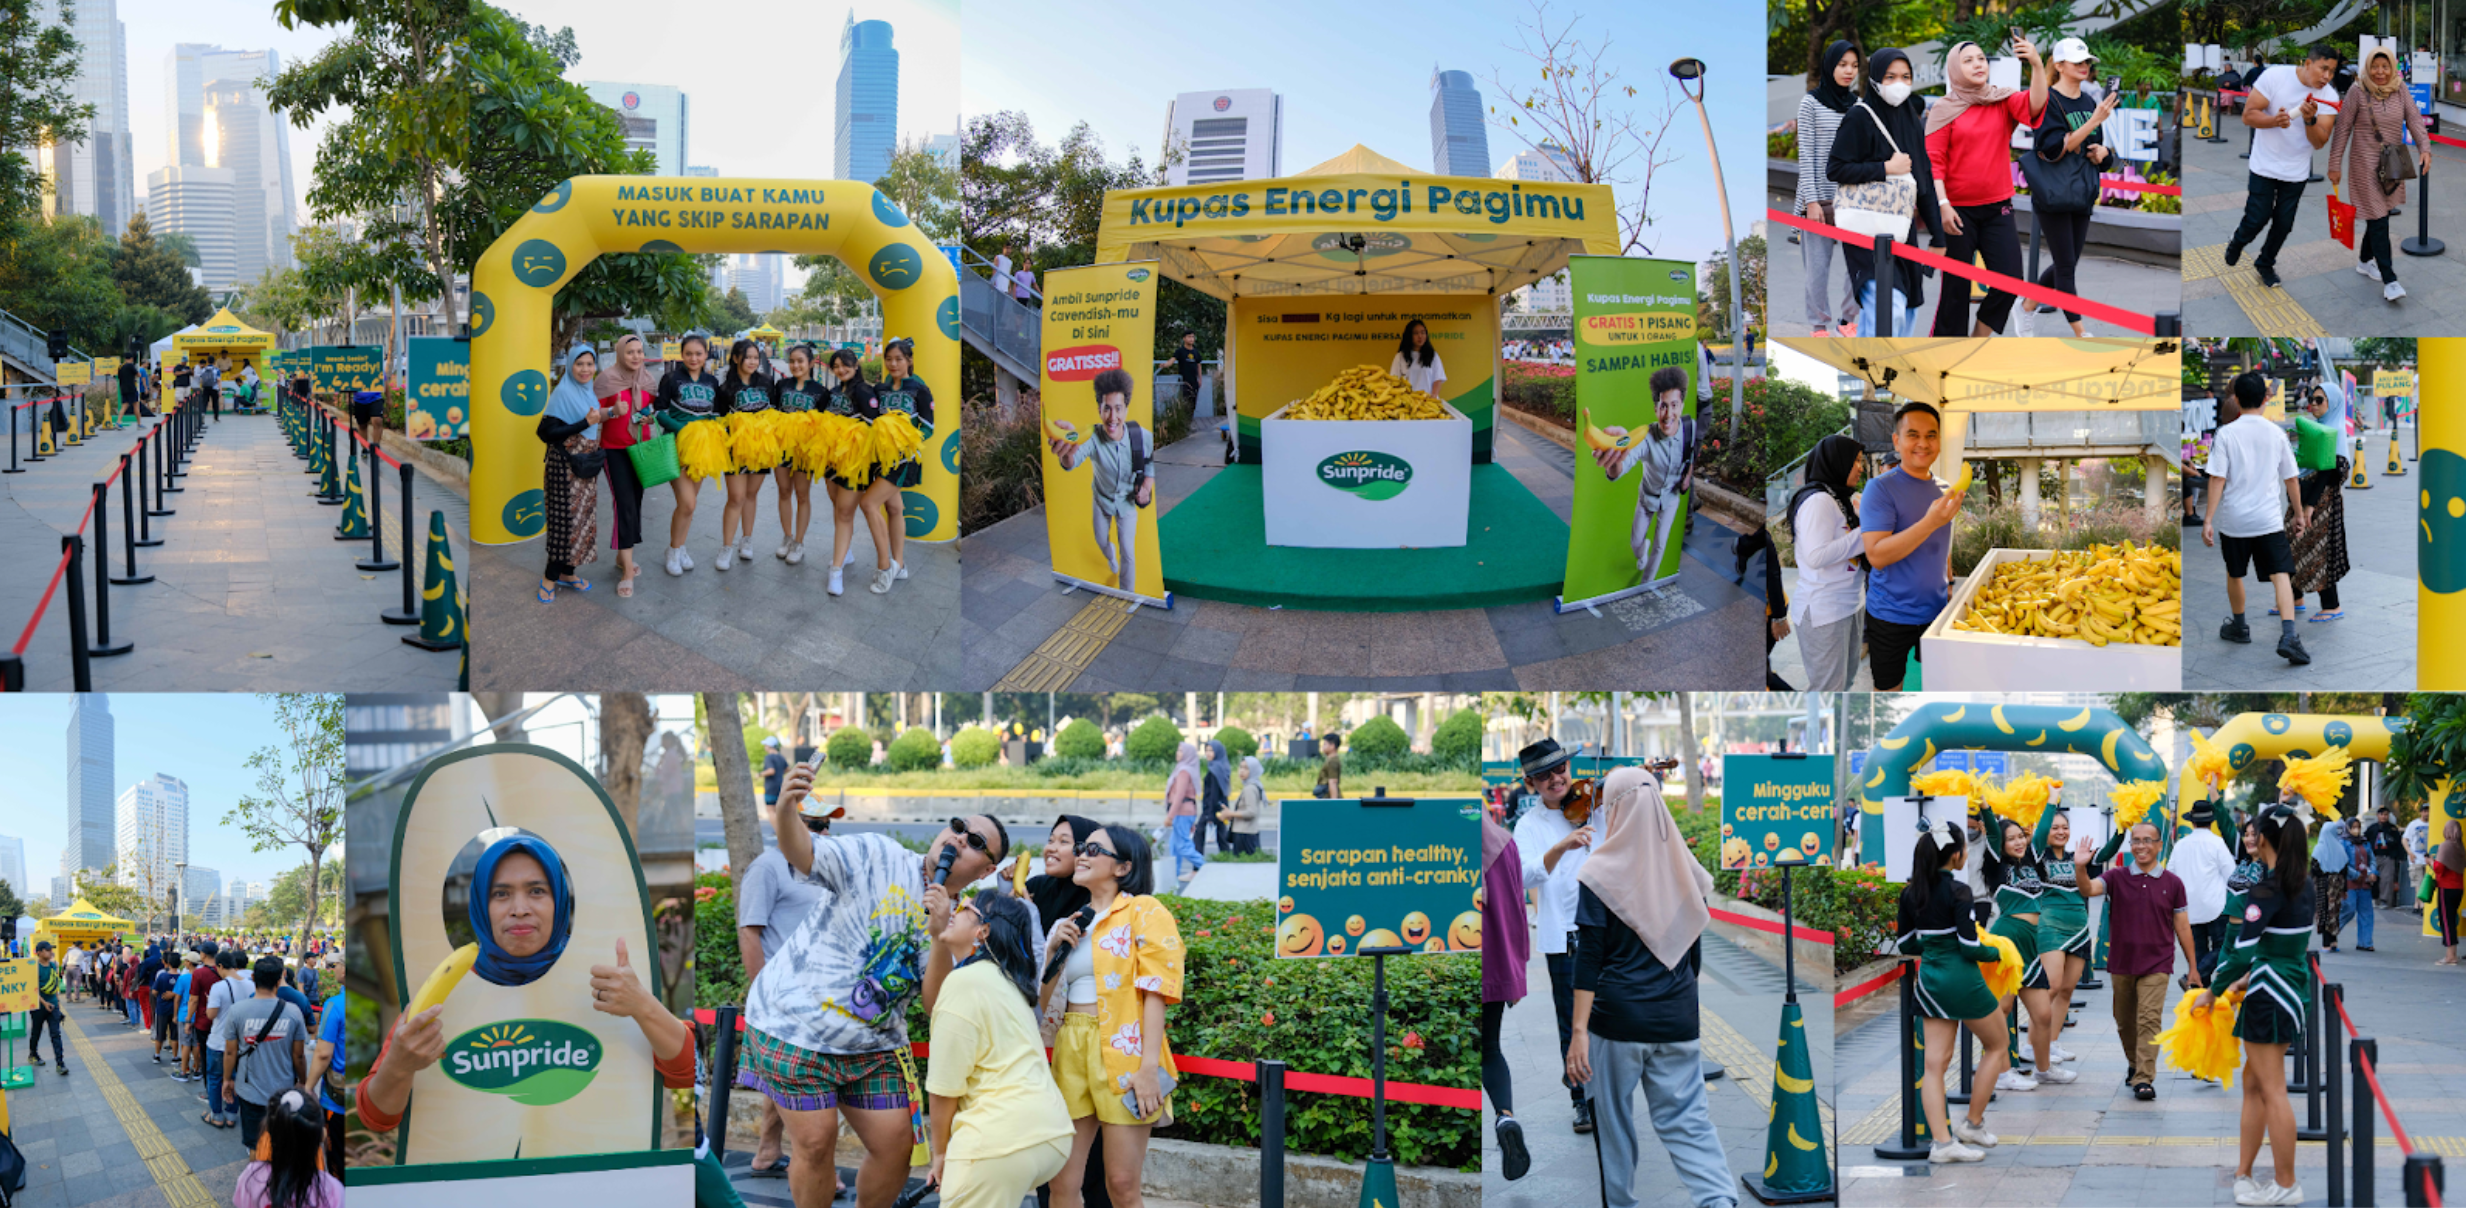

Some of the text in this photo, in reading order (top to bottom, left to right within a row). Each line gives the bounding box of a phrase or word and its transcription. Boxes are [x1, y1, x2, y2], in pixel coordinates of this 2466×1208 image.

[617, 185, 825, 205] MASUK BUAT KAMU
[1130, 180, 1585, 228] Kupas Energi Pagimu
[612, 208, 830, 230] YANG SKIP SARAPAN
[1051, 288, 1140, 305] Ambil Sunpride
[1586, 293, 1691, 307] Kupas Energi Pagimu
[1050, 306, 1139, 322] Cavendish-mu
[1257, 312, 1472, 323] Sisa Kg lagi untuk menamatkan
[1588, 316, 1692, 329] GRATIS 1 PISANG
[1072, 324, 1110, 339] Di Sini
[1263, 332, 1466, 341] KUPAS ENERGI PAGIMU BERSA NPRIDE
[1608, 332, 1677, 341] UNTUK 1 ORANG
[314, 361, 381, 375] I'm Ready!
[1586, 349, 1695, 373] SAMPAI HABIS!
[1322, 463, 1405, 484] Sunpride
[1753, 780, 1831, 801] Mingguku
[1300, 844, 1469, 867] Sarapan healthy,
[1286, 866, 1481, 891] senjata anti-cranky
[0, 981, 28, 995] NKY
[243, 1018, 291, 1033] PUA
